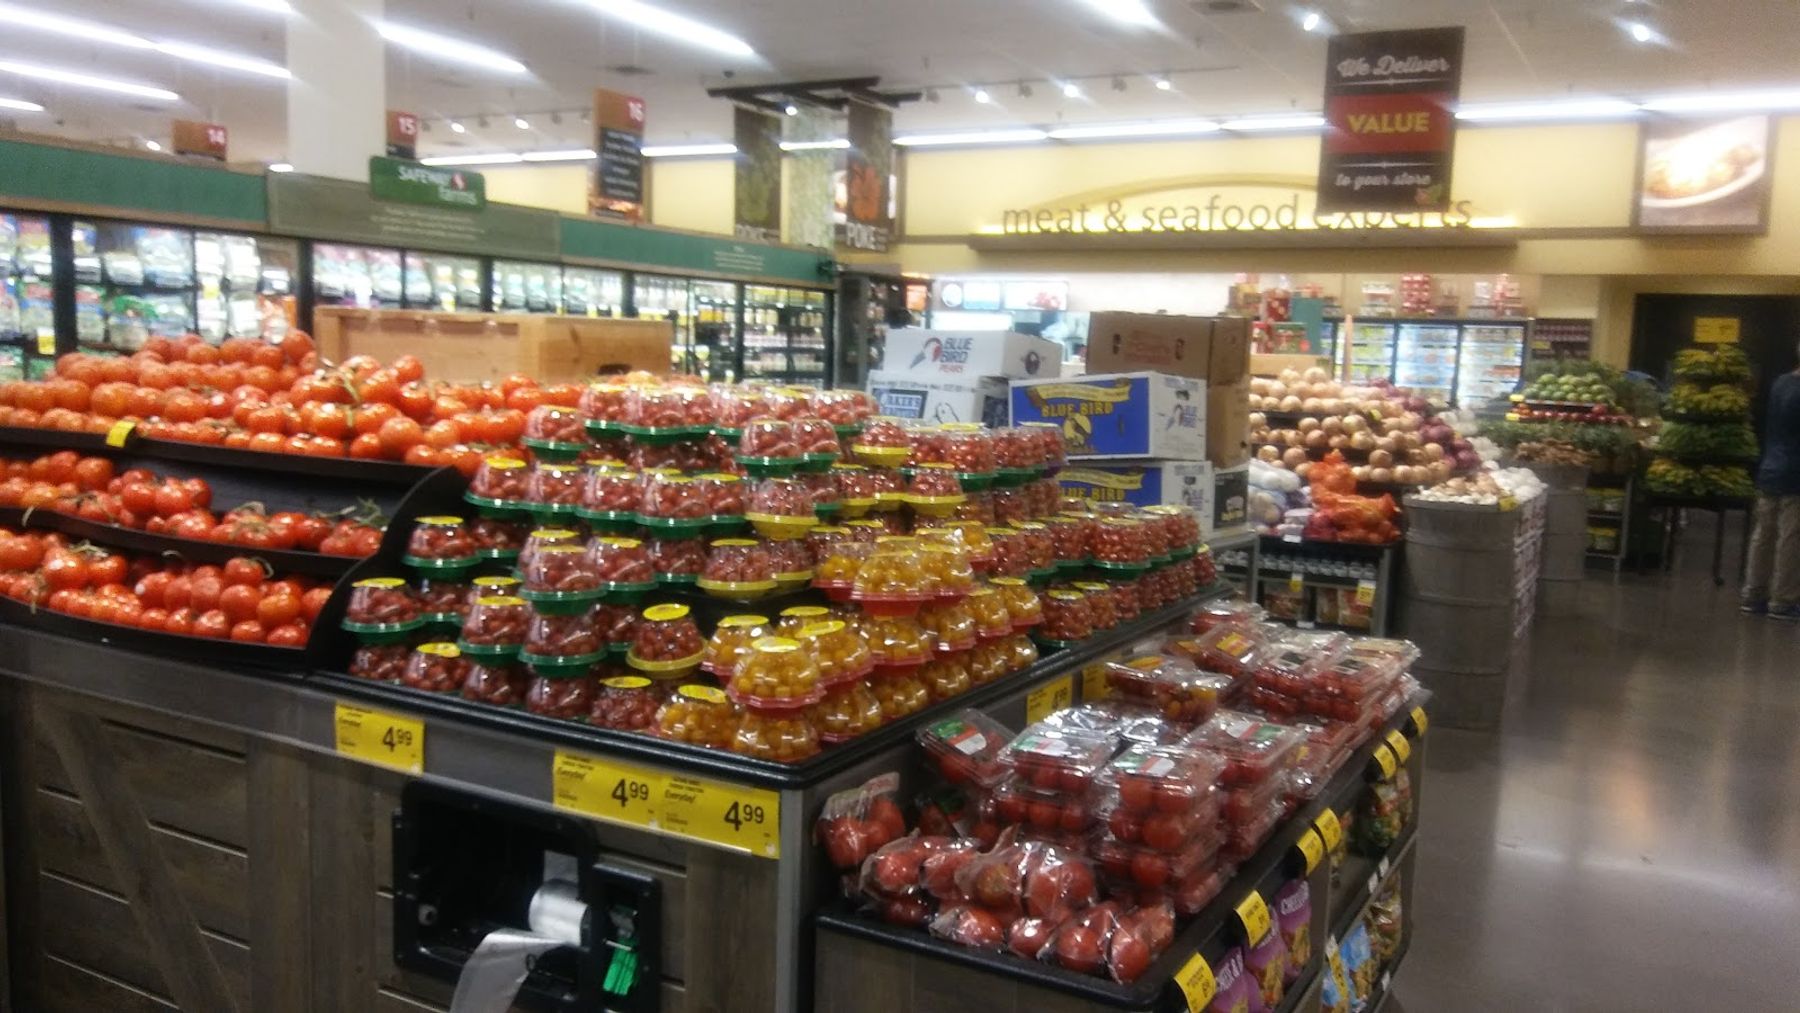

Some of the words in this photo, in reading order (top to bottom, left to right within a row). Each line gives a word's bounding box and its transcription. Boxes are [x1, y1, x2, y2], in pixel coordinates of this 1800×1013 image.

[1337, 57, 1370, 78] We
[1373, 55, 1450, 76] Deliver
[628, 101, 643, 121] 16
[400, 117, 416, 135] 15
[1347, 112, 1431, 133] VALUE
[208, 129, 225, 144] 14
[1335, 173, 1351, 186] to
[1353, 174, 1390, 191] your
[1392, 172, 1432, 186] store
[1003, 204, 1091, 234] meat
[1104, 200, 1127, 232] &
[1142, 193, 1299, 232] seafood
[943, 338, 973, 350] BLUE
[940, 351, 968, 363] BIRD
[1041, 403, 1075, 417] BLUE
[1080, 401, 1114, 416] BIRD
